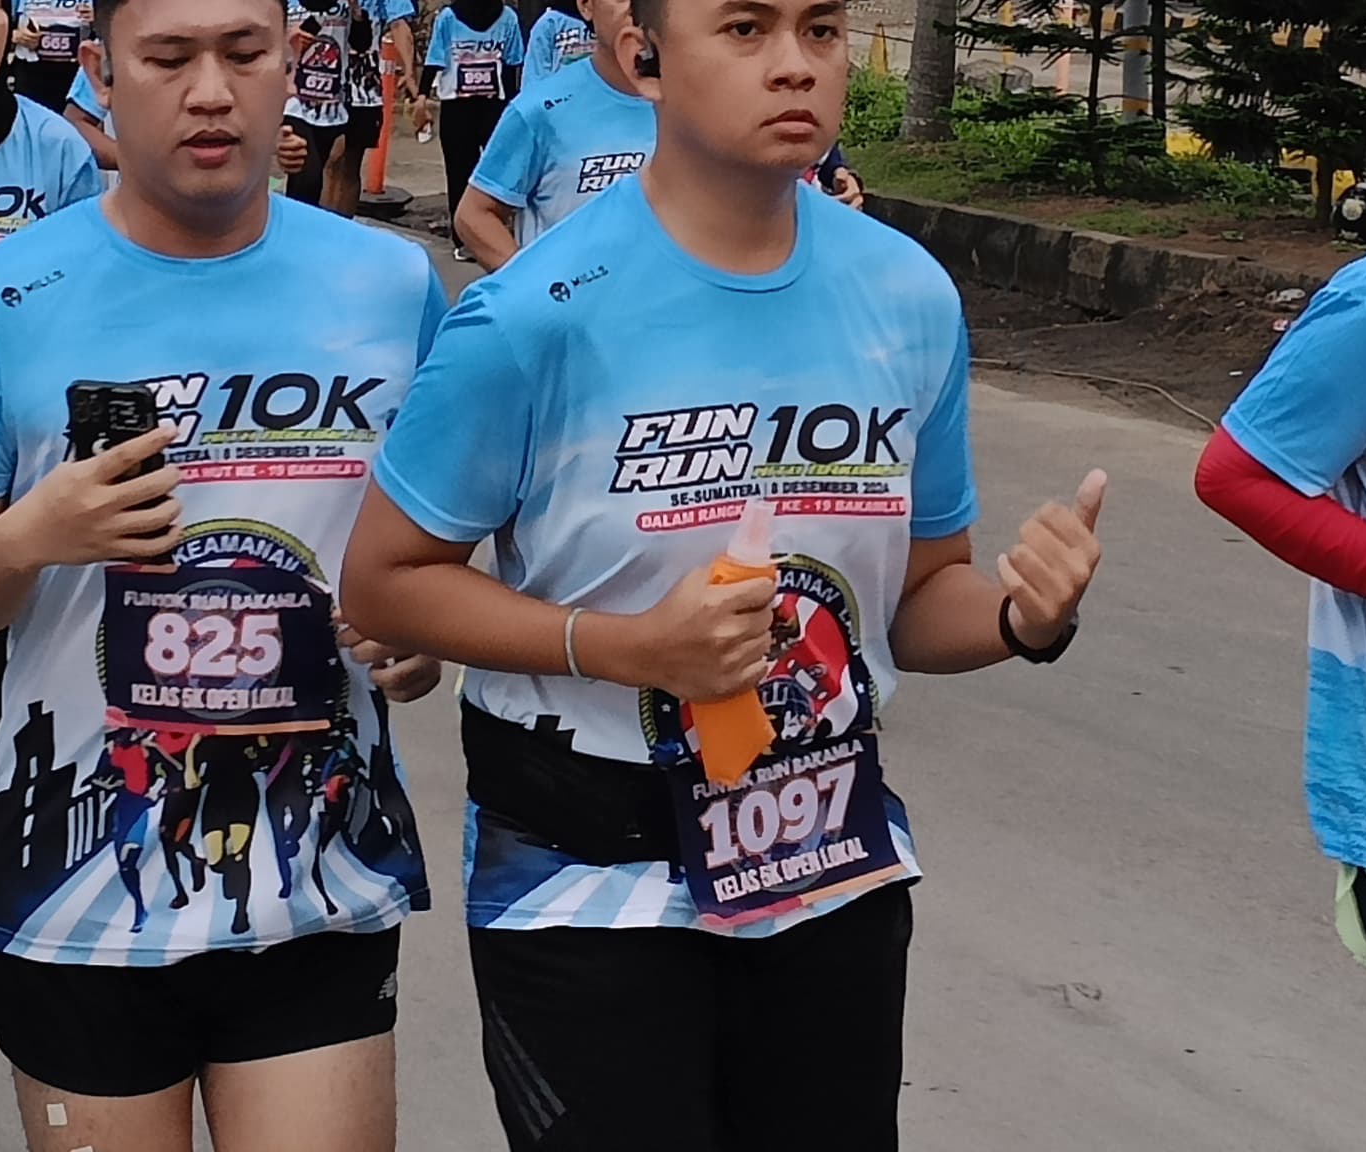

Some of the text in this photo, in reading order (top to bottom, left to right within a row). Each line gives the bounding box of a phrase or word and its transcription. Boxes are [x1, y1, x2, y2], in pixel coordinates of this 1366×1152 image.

[577, 173, 630, 193] RU
[581, 152, 645, 177] FUN
[217, 373, 387, 432] 10K
[617, 403, 911, 464] FUN 10K
[609, 442, 752, 493] RUN
[641, 511, 695, 529] DALAM
[780, 500, 801, 512] KE
[815, 500, 832, 512] 19
[671, 482, 760, 506] SE-SUMATERA
[782, 481, 858, 494] DESEMBER
[144, 613, 282, 676] 825
[755, 761, 789, 784] RUN
[792, 739, 864, 774] BAKAMLA
[698, 760, 856, 870] 1097
[713, 837, 869, 904] KELAS 5K OPEN LOKAL
